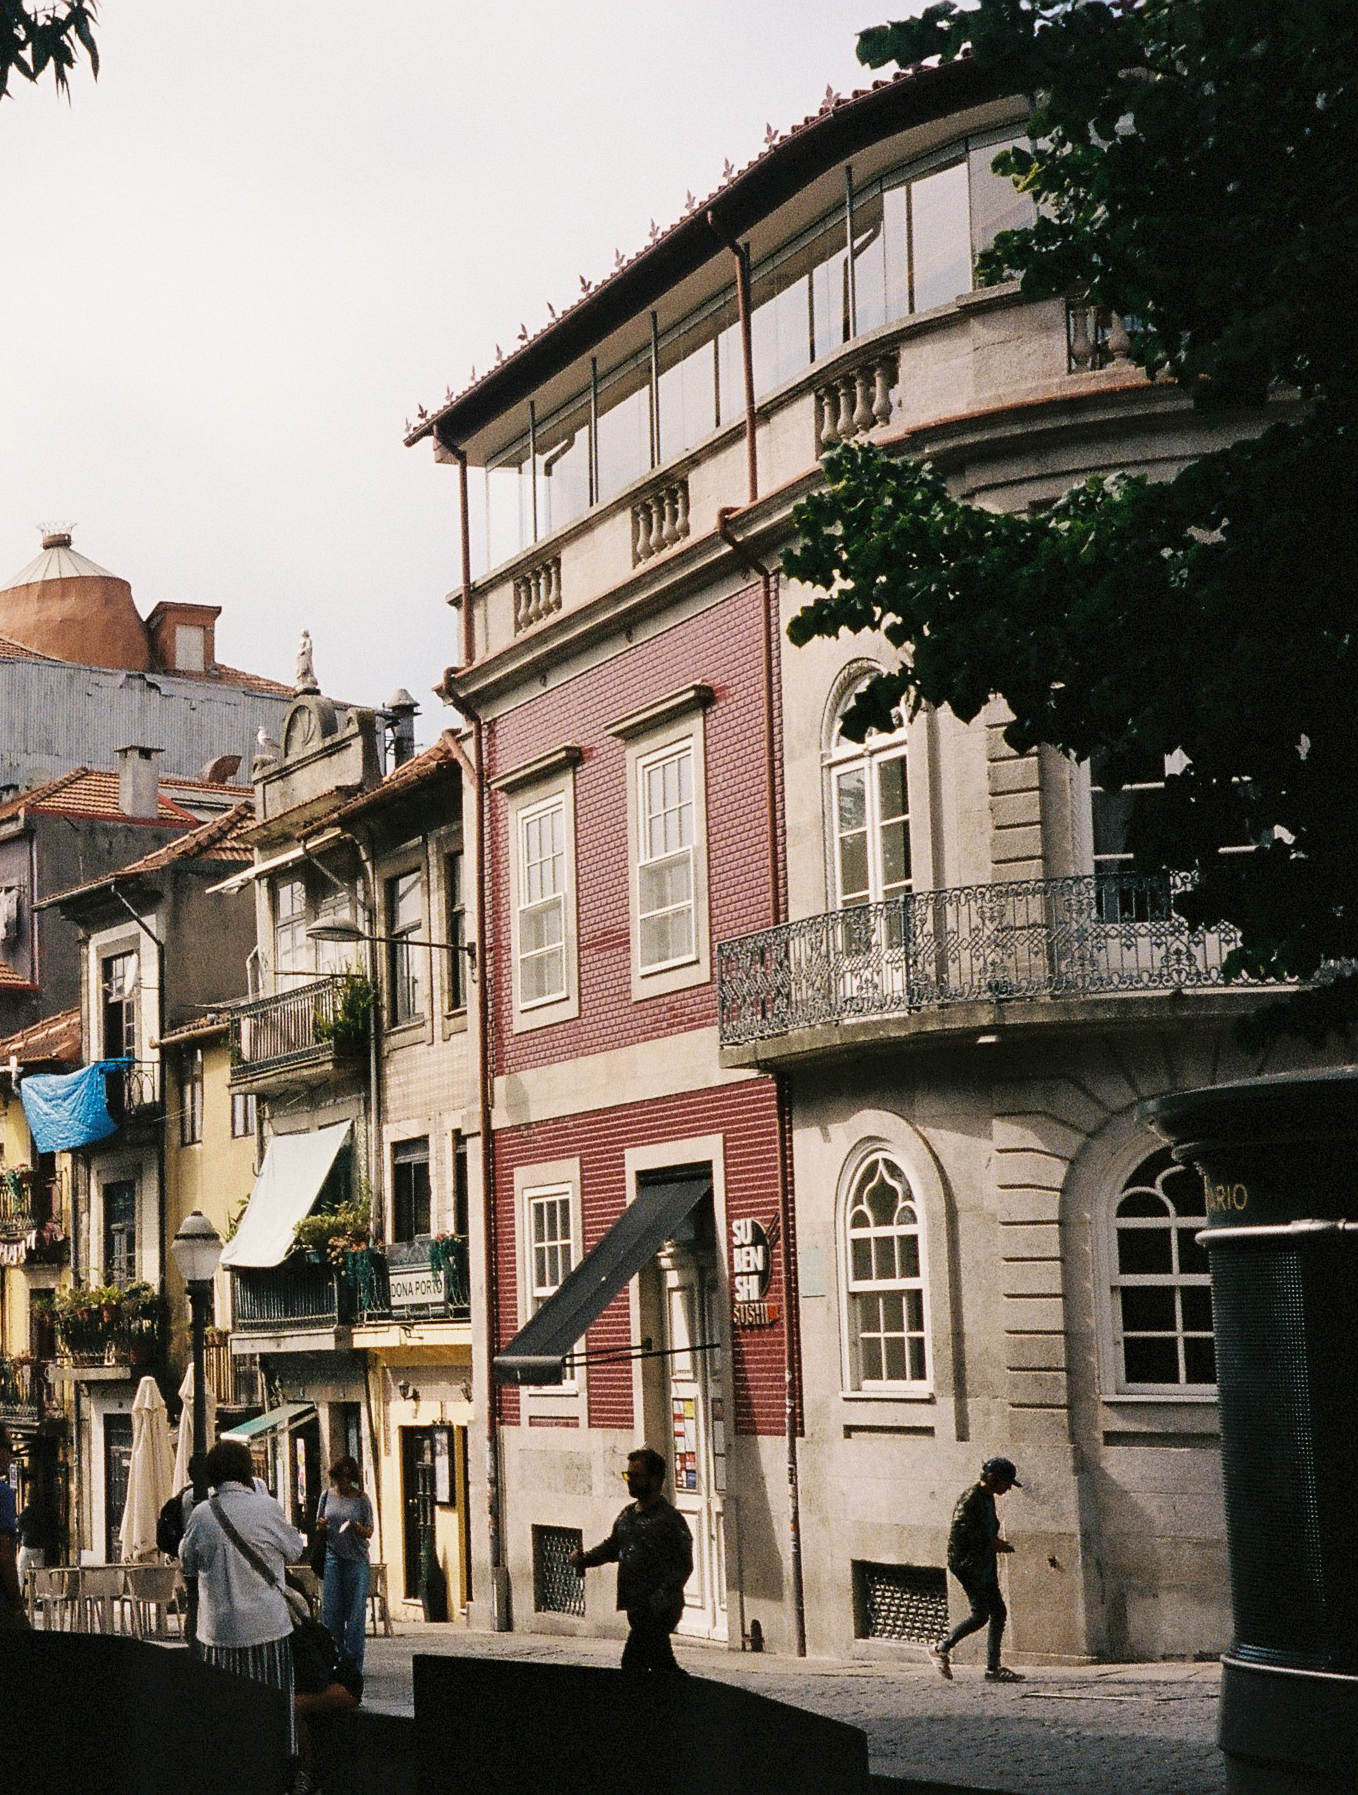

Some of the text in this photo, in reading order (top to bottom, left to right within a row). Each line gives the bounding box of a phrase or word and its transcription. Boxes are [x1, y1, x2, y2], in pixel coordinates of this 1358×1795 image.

[732, 1219, 752, 1246] SU
[733, 1246, 763, 1273] BEN
[390, 1282, 414, 1298] DONA
[734, 1274, 759, 1301] SHI
[733, 1303, 769, 1325] SUSHI
